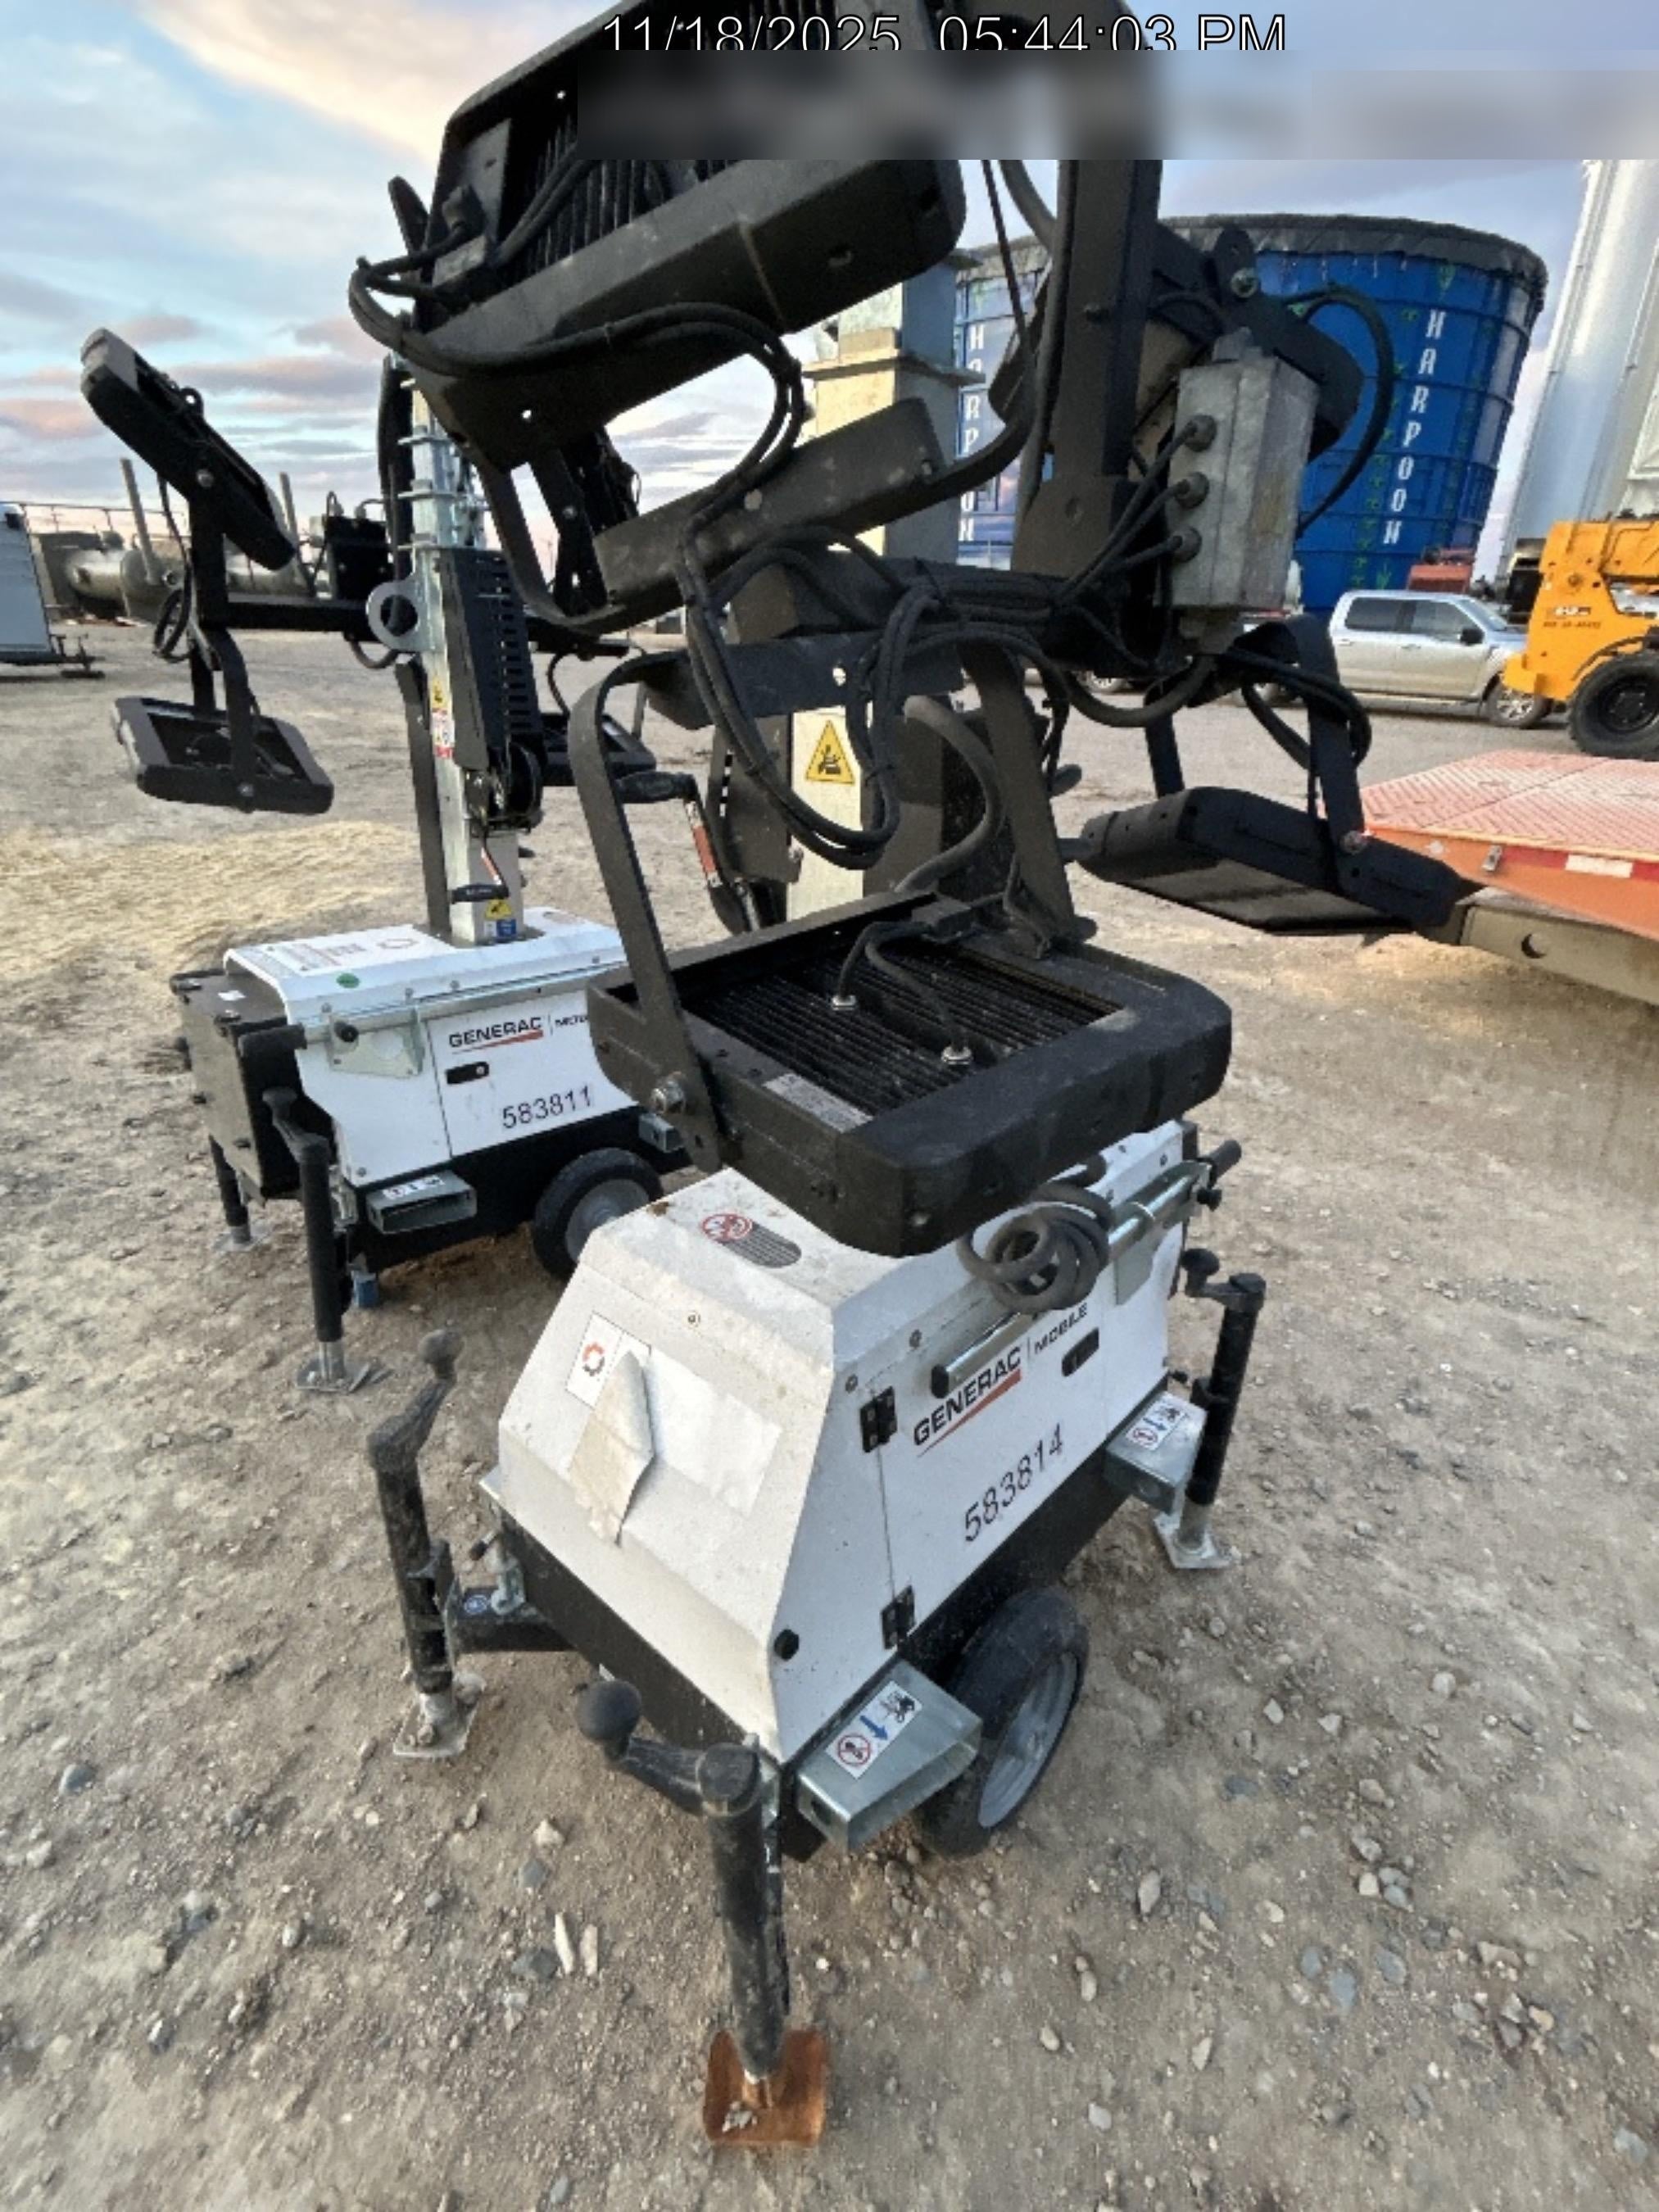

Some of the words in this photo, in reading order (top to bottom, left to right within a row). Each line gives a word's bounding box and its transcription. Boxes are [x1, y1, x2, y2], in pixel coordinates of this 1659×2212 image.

[1382, 308, 1447, 545] HARPOON
[448, 1016, 542, 1048] GENERAC
[501, 1083, 591, 1129] 583811
[913, 1345, 1022, 1447] GENERAC
[1034, 1301, 1088, 1355] MOBILE
[964, 1421, 1063, 1542] 583814
